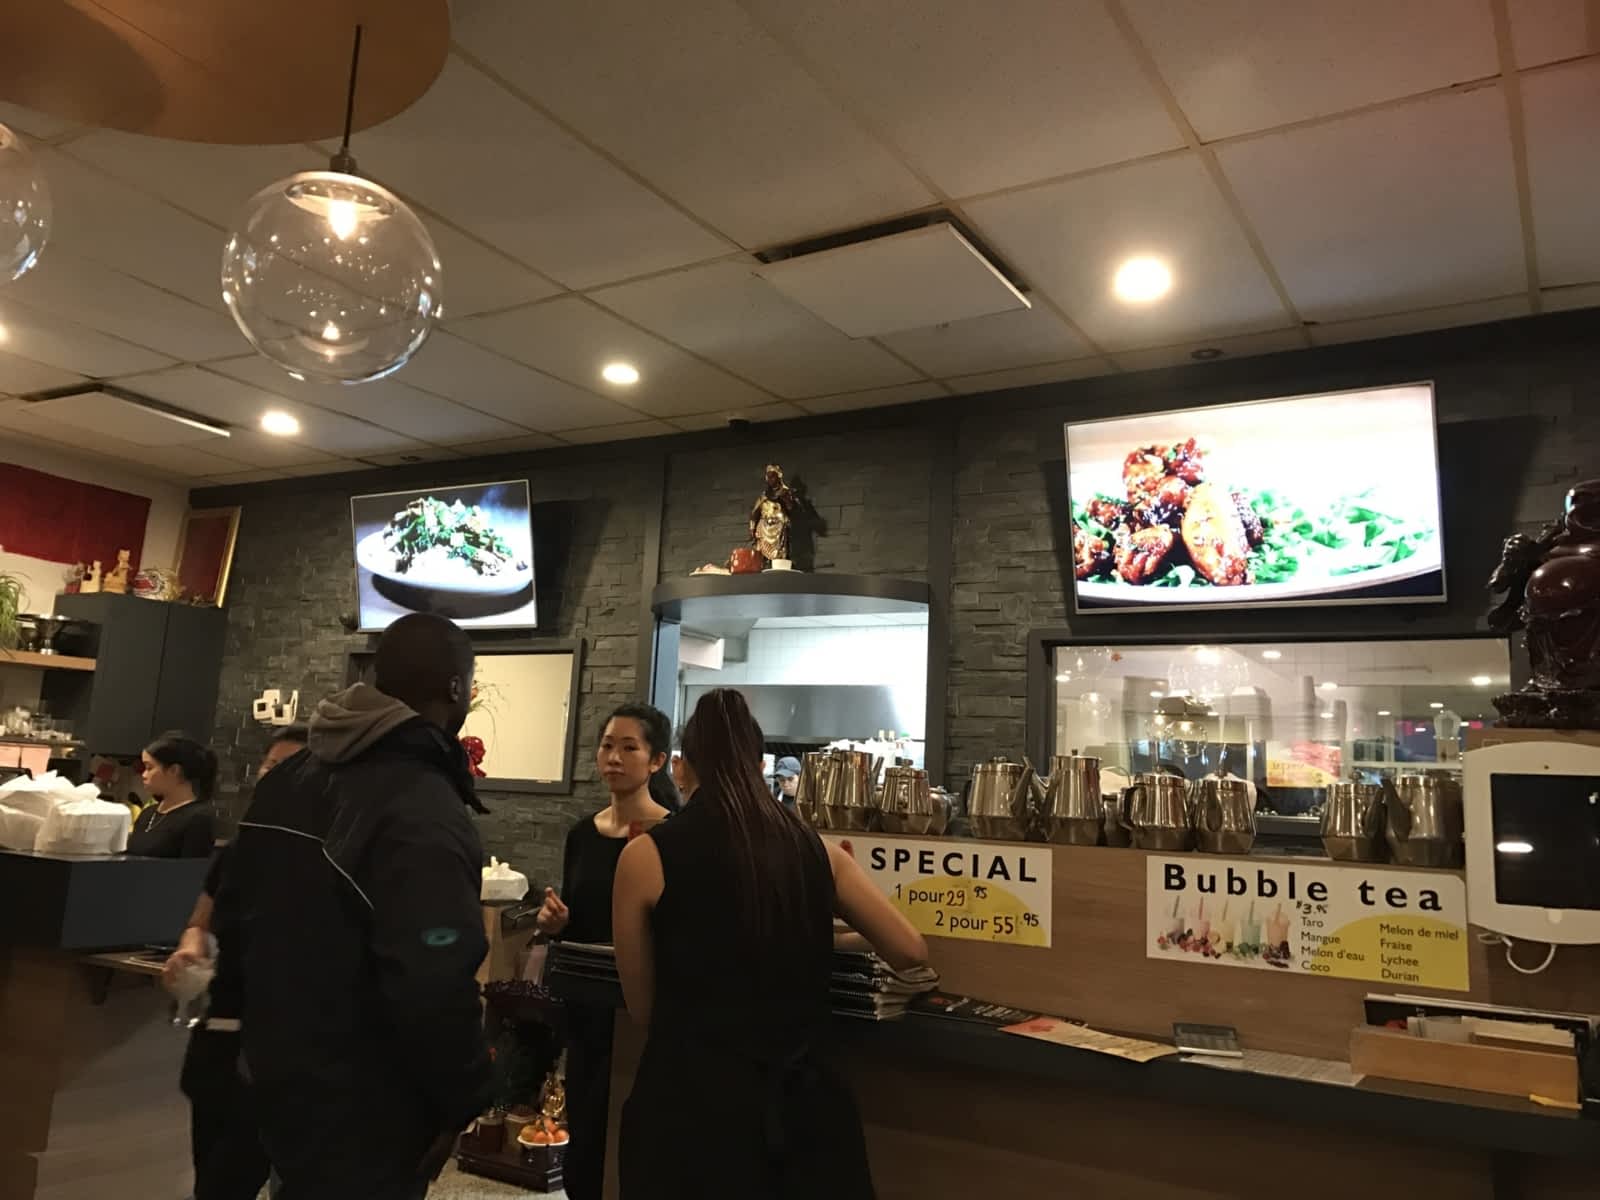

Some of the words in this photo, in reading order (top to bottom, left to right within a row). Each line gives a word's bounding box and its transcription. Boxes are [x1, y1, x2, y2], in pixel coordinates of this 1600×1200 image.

[871, 847, 1037, 882] SPECIAL
[1164, 863, 1328, 901] Bubble
[1358, 880, 1442, 911] tea
[895, 883, 902, 899] 1
[908, 888, 944, 905] pour
[946, 890, 965, 906] 29
[935, 911, 944, 926] 2
[950, 914, 989, 932] pour
[992, 916, 1014, 934] 55
[1301, 916, 1324, 928] Taro
[1301, 931, 1341, 945] Mangue
[1380, 923, 1414, 936] Melon
[1417, 928, 1432, 938] de
[1435, 930, 1459, 940] miel
[1380, 938, 1413, 951] Fraise
[1301, 946, 1334, 957] Melon
[1337, 949, 1365, 961] d'eau
[1381, 953, 1419, 967] Lychee
[1301, 960, 1330, 972] Coco
[1381, 968, 1420, 982] Durian
